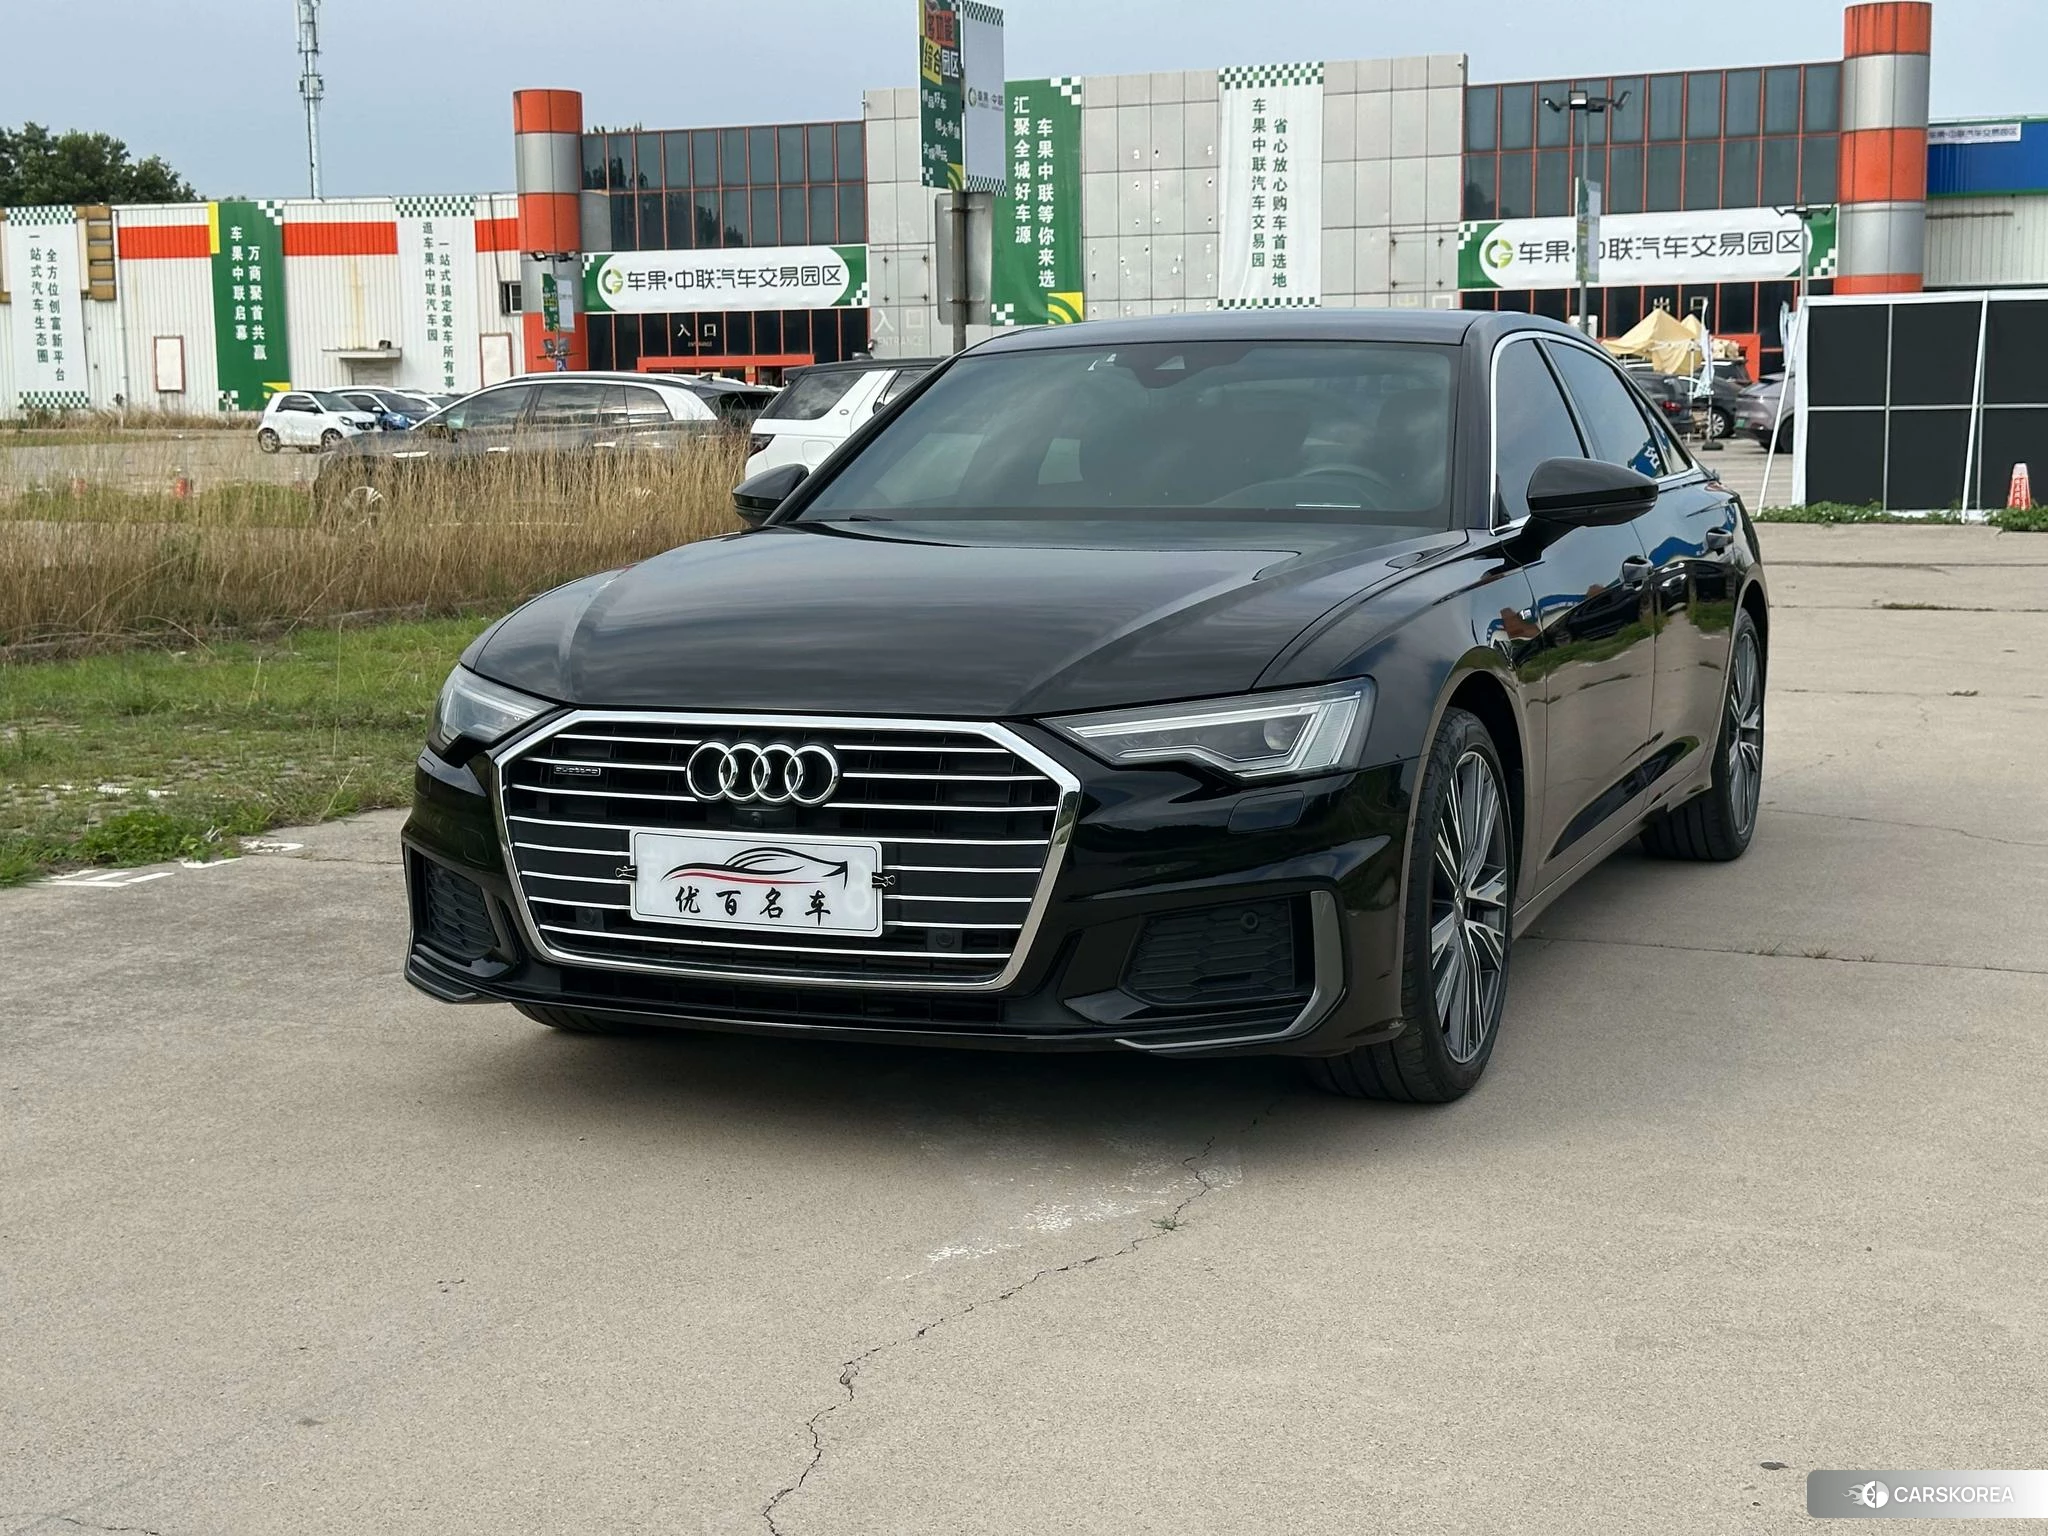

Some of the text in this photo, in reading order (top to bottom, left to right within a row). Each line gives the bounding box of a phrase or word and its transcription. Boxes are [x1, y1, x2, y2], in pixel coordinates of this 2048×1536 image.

[924, 42, 959, 78] 综合园区
[1013, 96, 1032, 244] 汇聚全城好车源
[1037, 118, 1056, 288] 车果中联等你来选
[1252, 98, 1267, 268] 车果中联汽车交易园
[1272, 118, 1288, 288] 省心放心购车首选地
[29, 235, 49, 364] 一站式汽车生态圈
[46, 248, 65, 382] 全方位创富新平台
[231, 226, 248, 341] 车果中联启幕
[248, 246, 267, 360] 万商聚首共赢
[438, 242, 455, 389] 一站式搞定爱车所有事
[677, 323, 717, 337] 入口
[675, 886, 832, 926] 优百名车
